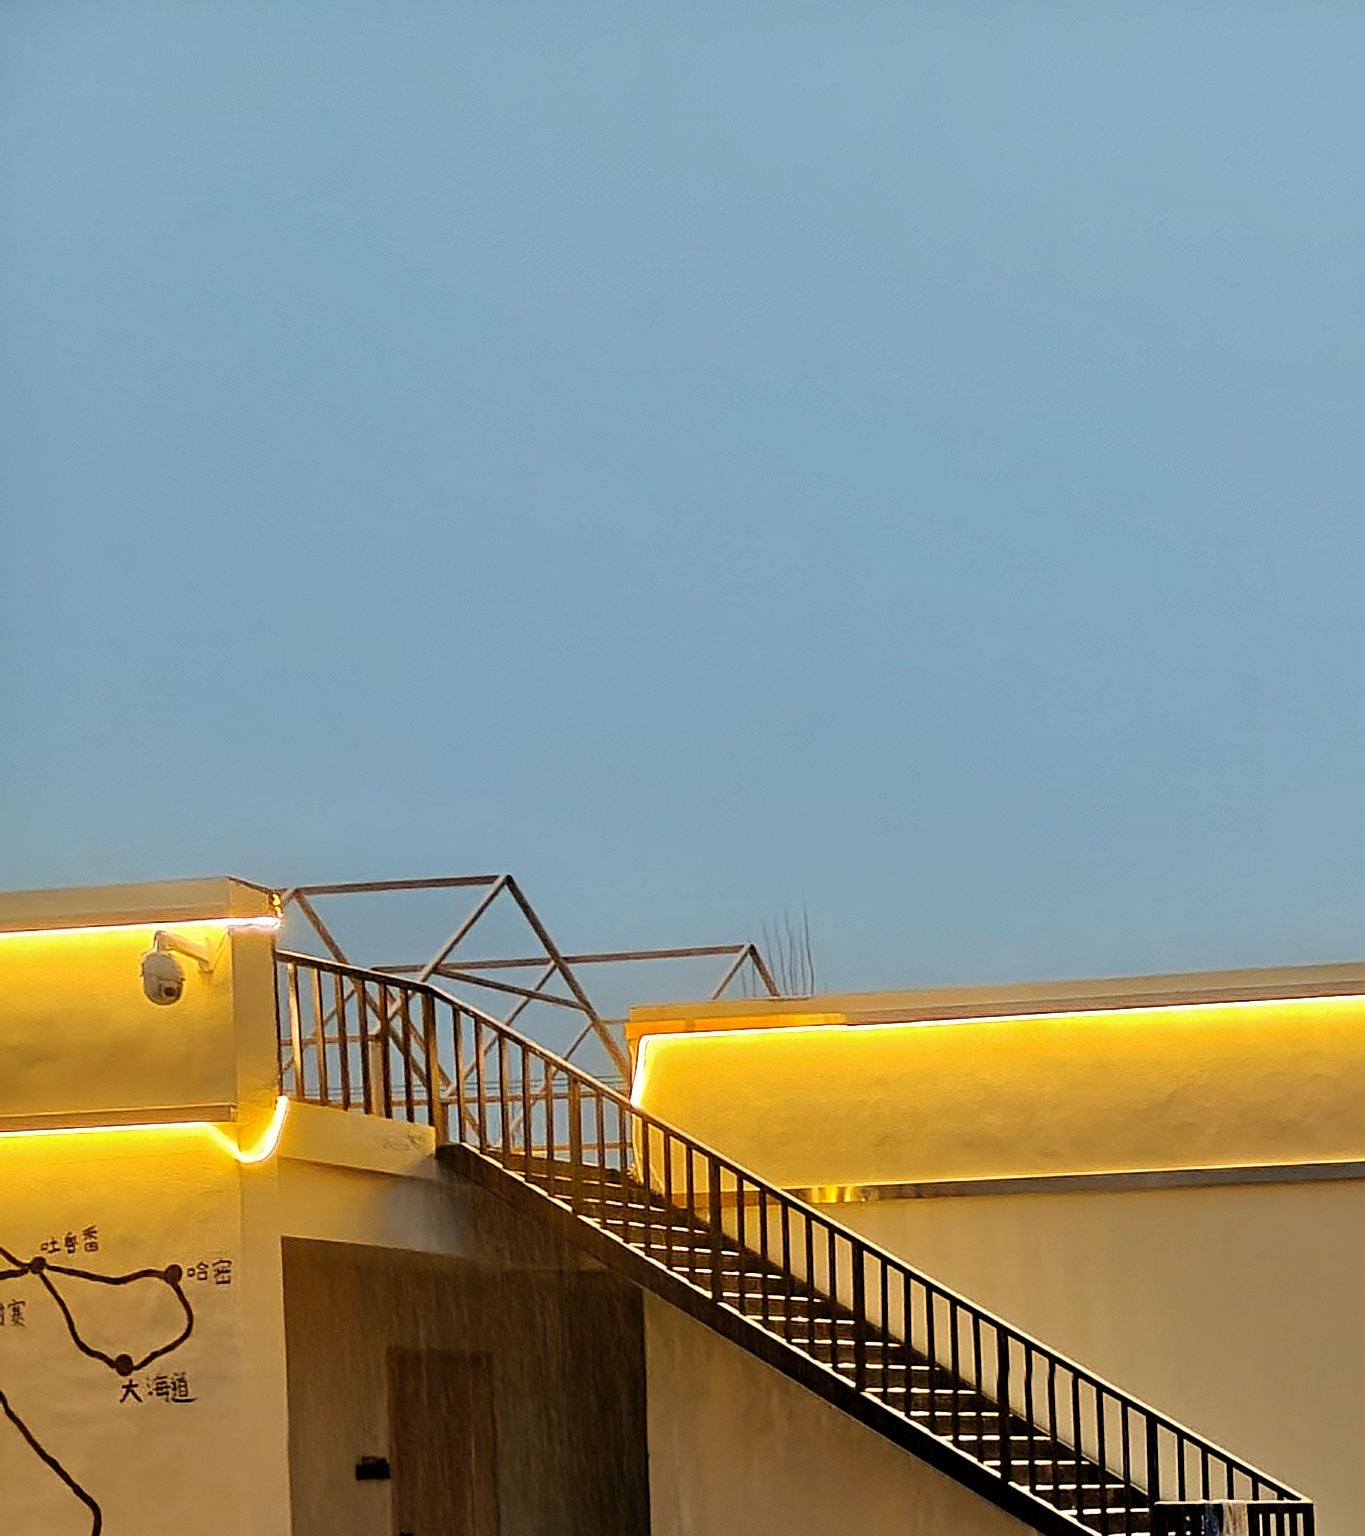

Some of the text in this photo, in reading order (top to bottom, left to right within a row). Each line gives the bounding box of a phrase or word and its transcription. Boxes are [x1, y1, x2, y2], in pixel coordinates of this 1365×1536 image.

[40, 1224, 99, 1254] 吐鲁番
[187, 1258, 232, 1285] 哈密
[119, 1372, 198, 1403] 大海道
